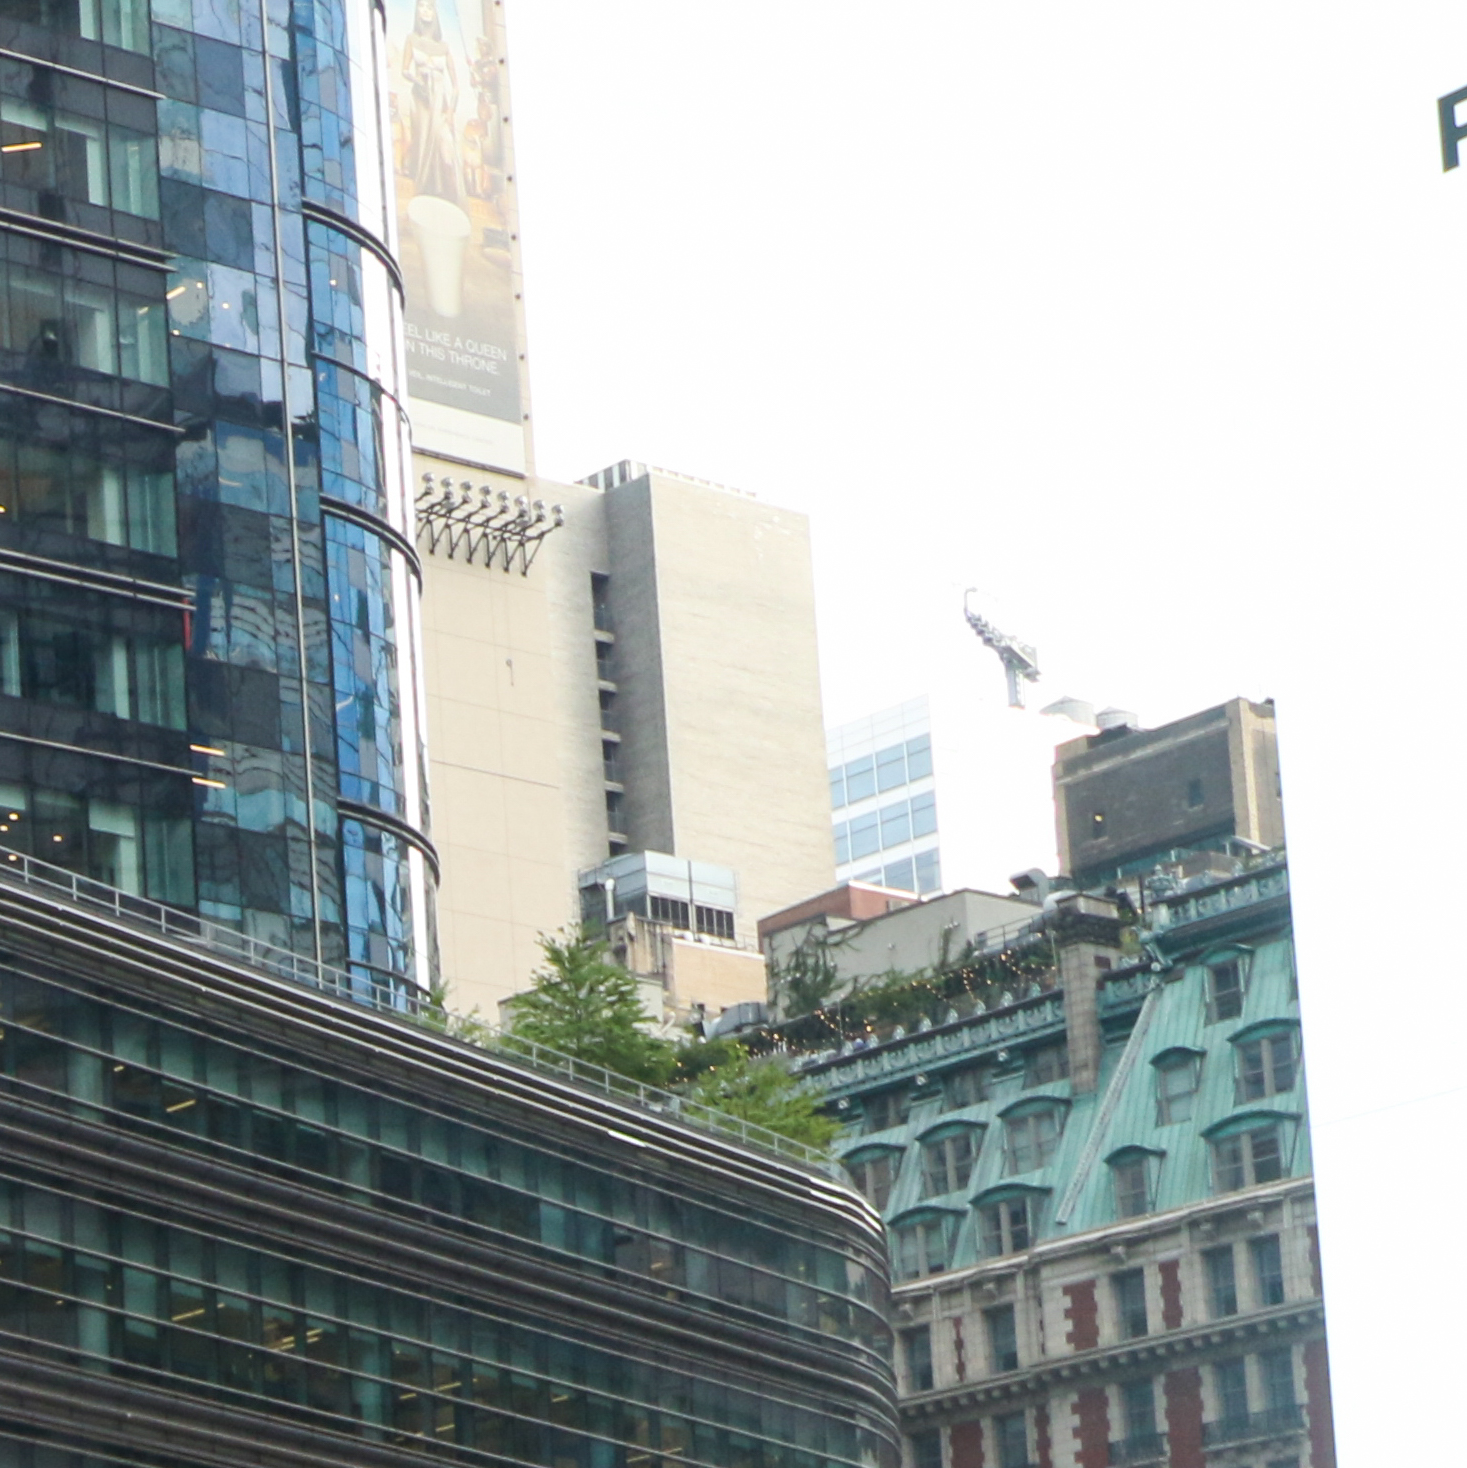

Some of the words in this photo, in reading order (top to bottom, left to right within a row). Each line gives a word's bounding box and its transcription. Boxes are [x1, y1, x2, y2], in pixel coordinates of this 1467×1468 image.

[418, 343, 446, 363] THIS
[425, 328, 451, 347] LIKE
[453, 336, 464, 350] A
[466, 339, 507, 362] QUEEN
